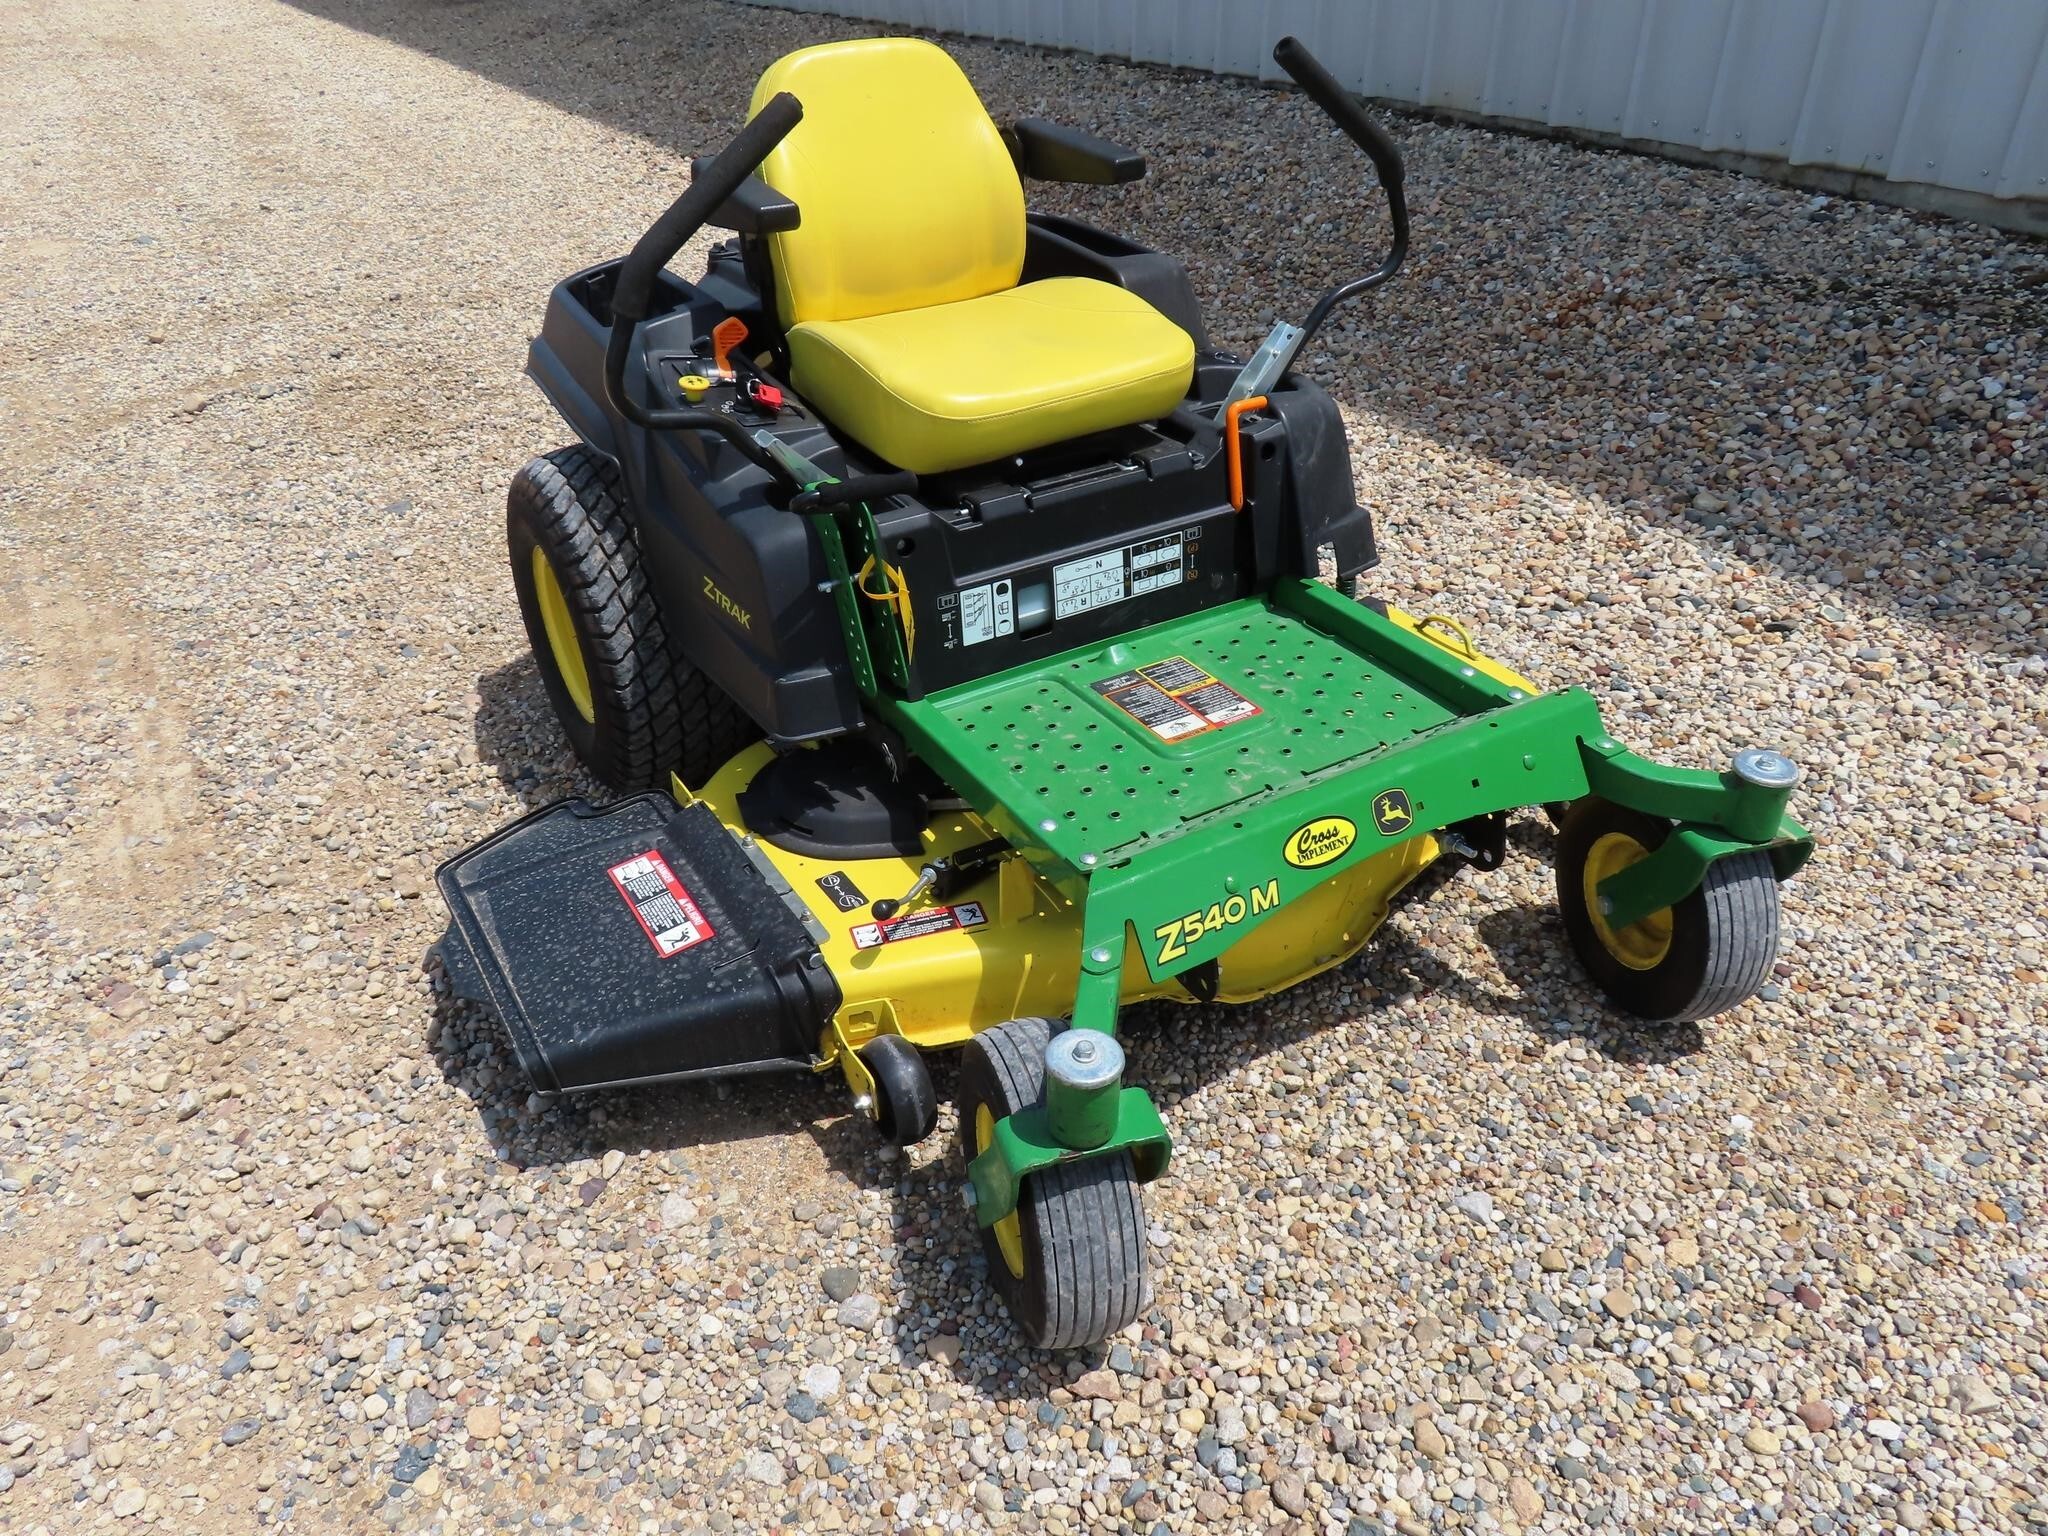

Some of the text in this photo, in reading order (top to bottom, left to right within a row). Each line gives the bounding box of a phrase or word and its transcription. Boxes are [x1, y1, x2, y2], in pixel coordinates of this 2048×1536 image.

[703, 575, 751, 630] ZTRAK
[1296, 835, 1350, 864] IMPLEMENT
[1297, 824, 1340, 854] Cross
[1154, 878, 1280, 965] Z540 M
